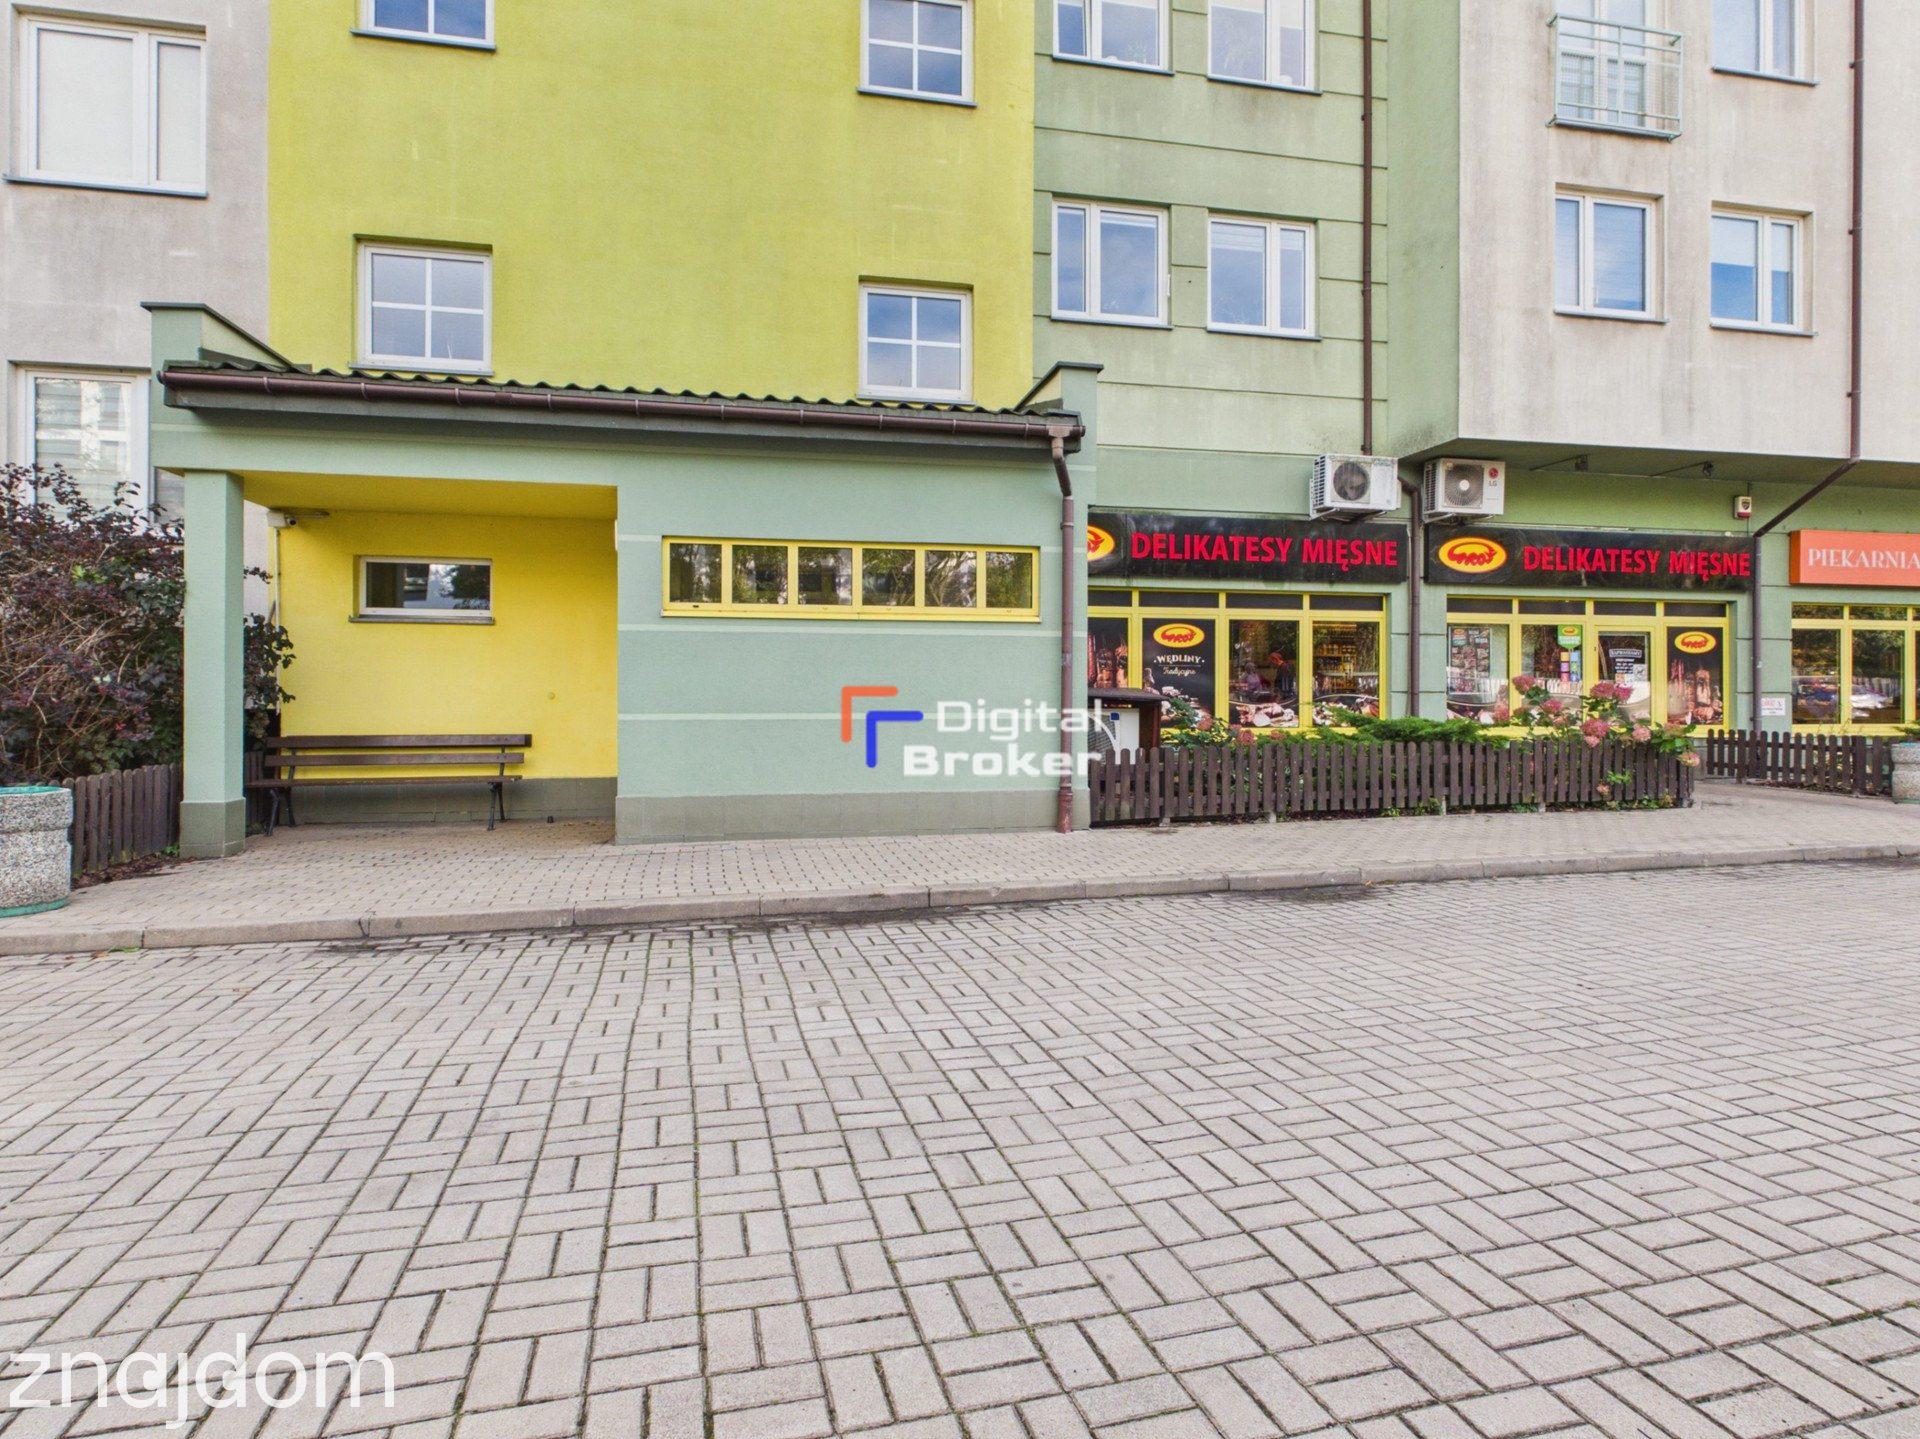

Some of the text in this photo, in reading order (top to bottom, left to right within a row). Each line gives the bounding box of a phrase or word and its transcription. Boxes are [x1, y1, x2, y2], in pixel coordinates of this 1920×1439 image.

[1131, 531, 1398, 572] DELIKATESY MIĘSNE
[1523, 545, 1751, 582] DELIKATESY MIĘSNE
[1807, 548, 1920, 570] PIEKARNIA
[1156, 654, 1202, 664] WĘDLINY
